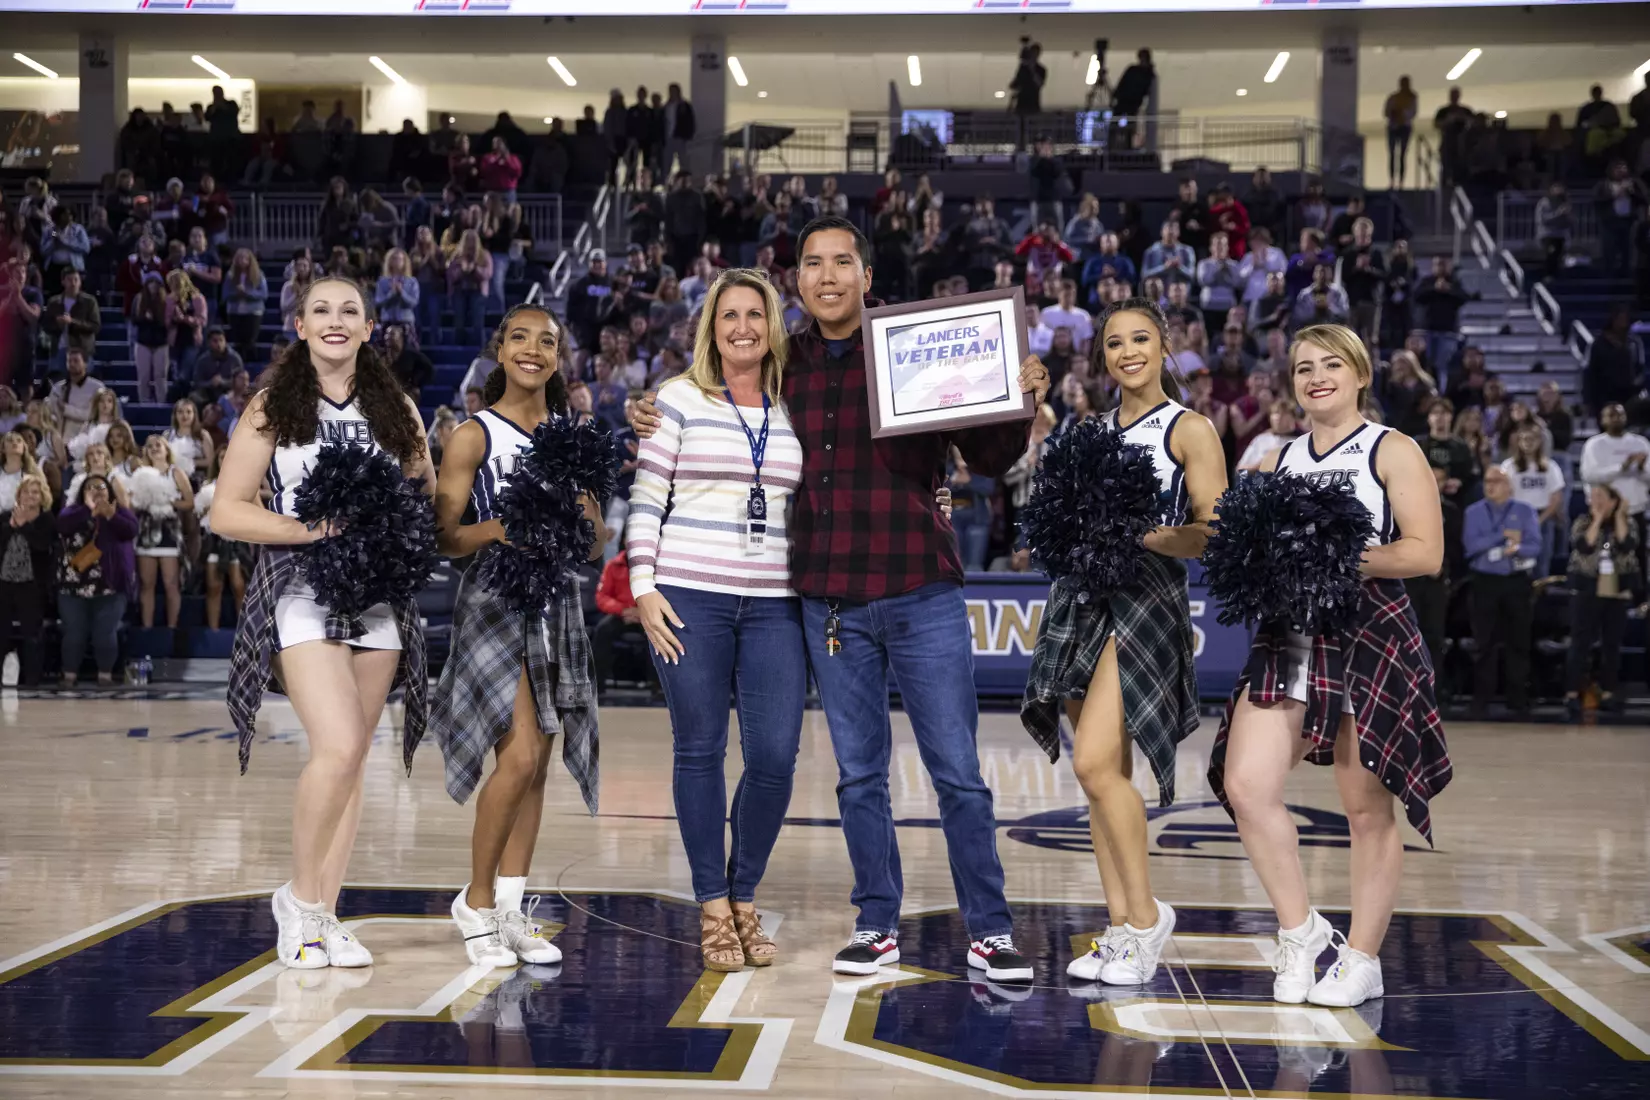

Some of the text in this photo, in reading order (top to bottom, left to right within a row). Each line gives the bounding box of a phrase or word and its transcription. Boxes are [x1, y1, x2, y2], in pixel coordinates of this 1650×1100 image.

[917, 325, 980, 345] LANCERS
[895, 338, 999, 365] VETERAN
[937, 358, 959, 368] THE
[964, 352, 997, 364] GAME
